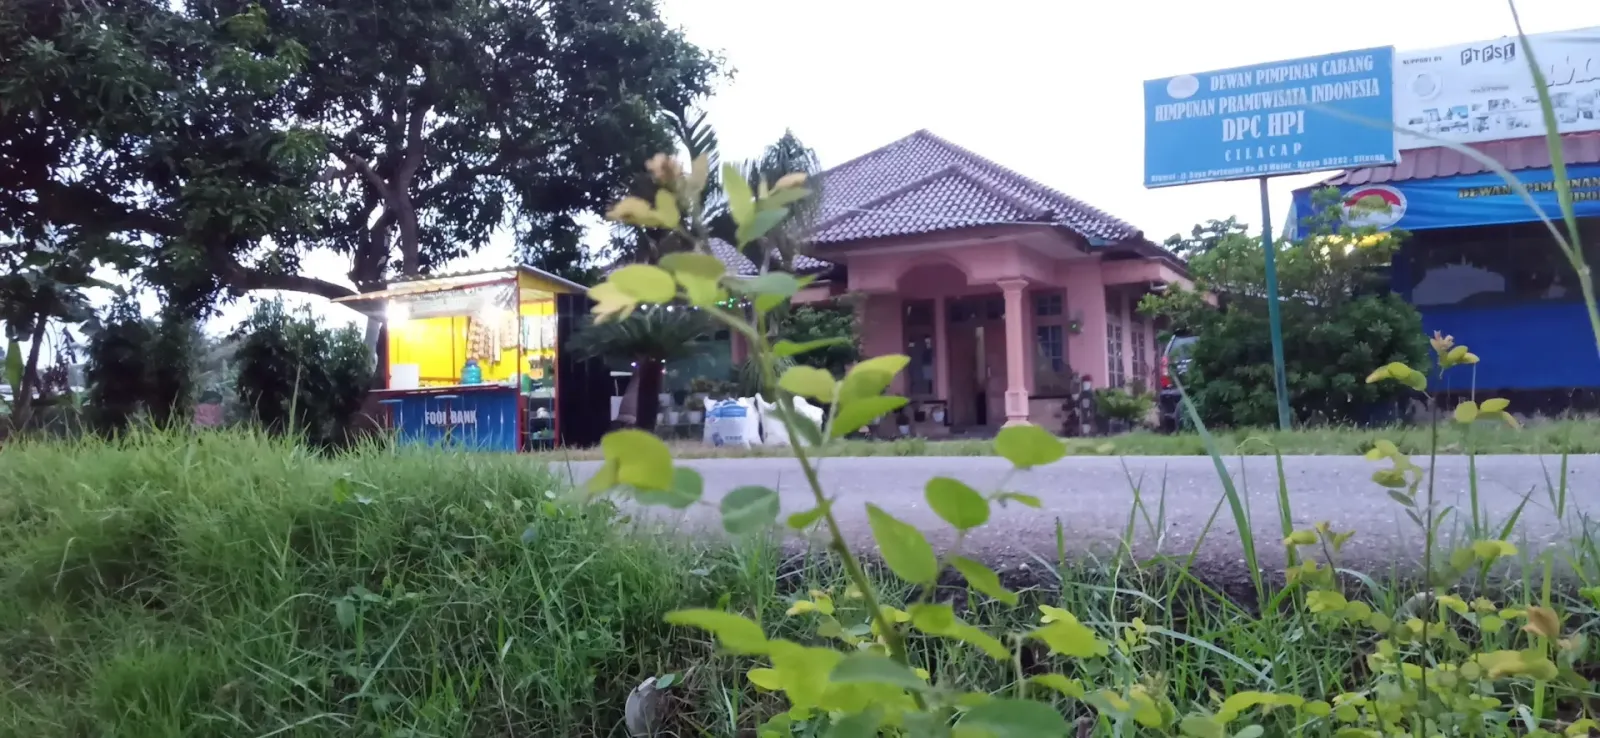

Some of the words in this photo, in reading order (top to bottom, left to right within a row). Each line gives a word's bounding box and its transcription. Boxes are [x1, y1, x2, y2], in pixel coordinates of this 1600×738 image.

[1460, 42, 1515, 66] PTPSI
[1210, 71, 1251, 92] DEWAN
[1256, 62, 1318, 86] PIMPINAN
[1322, 54, 1374, 77] CABANG
[1155, 98, 1215, 122] HIMPUNAN
[1218, 87, 1307, 115] PRAMUWISATA
[1311, 78, 1380, 103] INDONESIA
[1222, 115, 1261, 142] DPC
[1267, 110, 1305, 137] HPI
[1225, 142, 1302, 162] CILACAP
[1459, 184, 1512, 198] DEWAN
[450, 410, 477, 424] BANK
